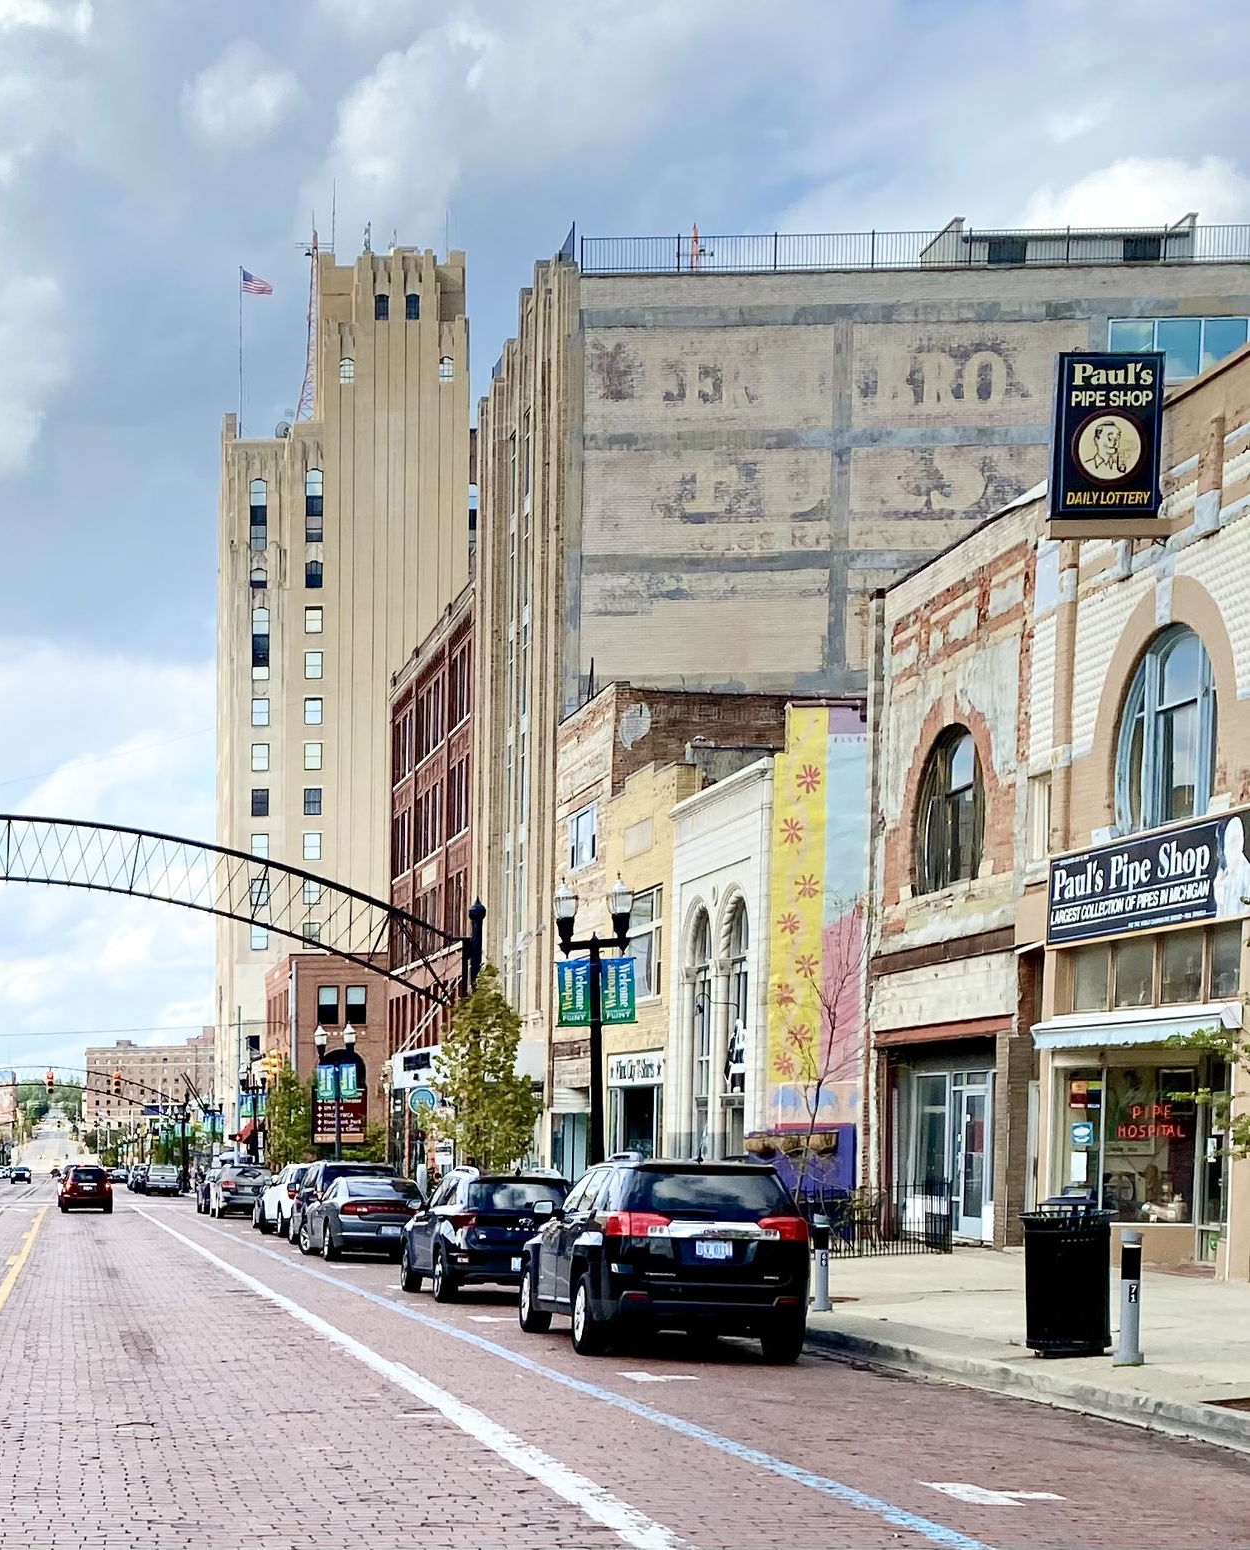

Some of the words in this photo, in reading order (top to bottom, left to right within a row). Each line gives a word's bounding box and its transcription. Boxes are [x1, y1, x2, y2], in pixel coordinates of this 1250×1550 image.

[1072, 362, 1154, 386] Paul's
[1071, 391, 1106, 407] PIPE
[1109, 391, 1153, 407] SHOP
[1066, 491, 1099, 505] DAILY
[1100, 491, 1150, 505] LOTTERY
[1053, 860, 1104, 901] Paul's
[1109, 853, 1152, 892] Pipe
[1157, 840, 1210, 879] Shop
[1050, 906, 1081, 926] LARGEST
[1081, 897, 1124, 920] COLLECTION
[1125, 895, 1137, 912] OF
[1137, 890, 1159, 910] PIPES
[1160, 888, 1169, 906] IN
[1169, 880, 1210, 904] MICHIGAN
[561, 967, 574, 1011] Welcome
[575, 965, 588, 1010] Welcome
[604, 965, 617, 1009] Welcome
[619, 963, 632, 1008] Welcome
[1132, 1104, 1173, 1119] PIPE
[1117, 1124, 1186, 1138] HOSPITAL
[1130, 1284, 1137, 1302] 71
